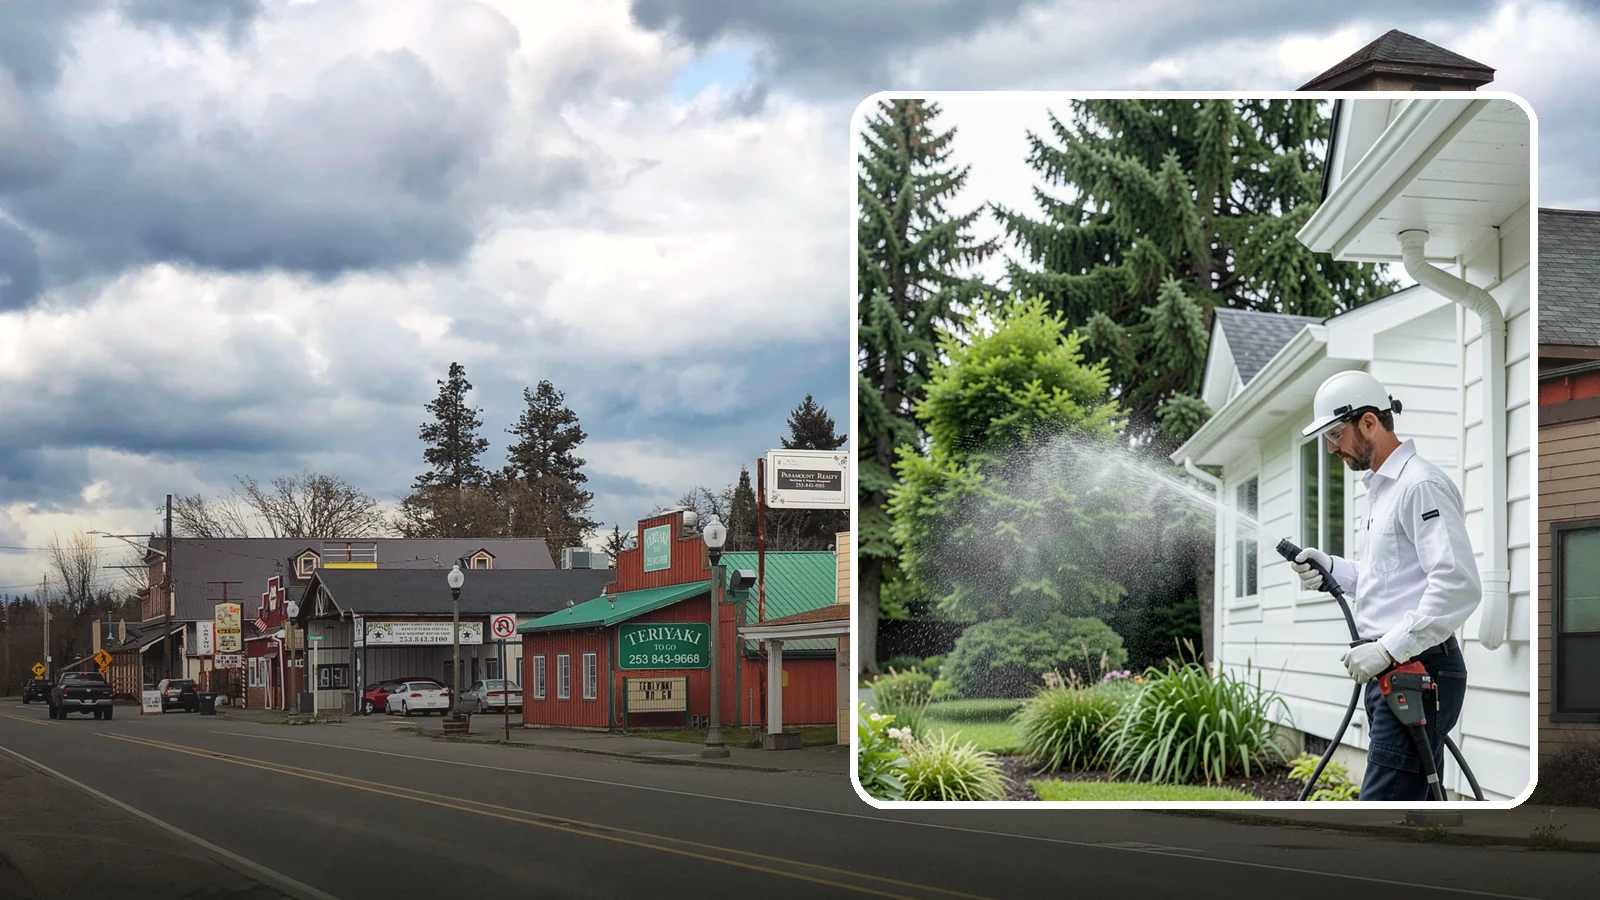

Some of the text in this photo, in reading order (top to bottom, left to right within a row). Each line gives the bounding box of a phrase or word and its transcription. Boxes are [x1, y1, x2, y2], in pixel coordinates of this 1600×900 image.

[646, 532, 669, 548] TERIYAKI
[625, 628, 702, 646] TERIYAKI
[629, 654, 700, 664] 253 843-9668
[639, 681, 672, 690] TERIYAKI
